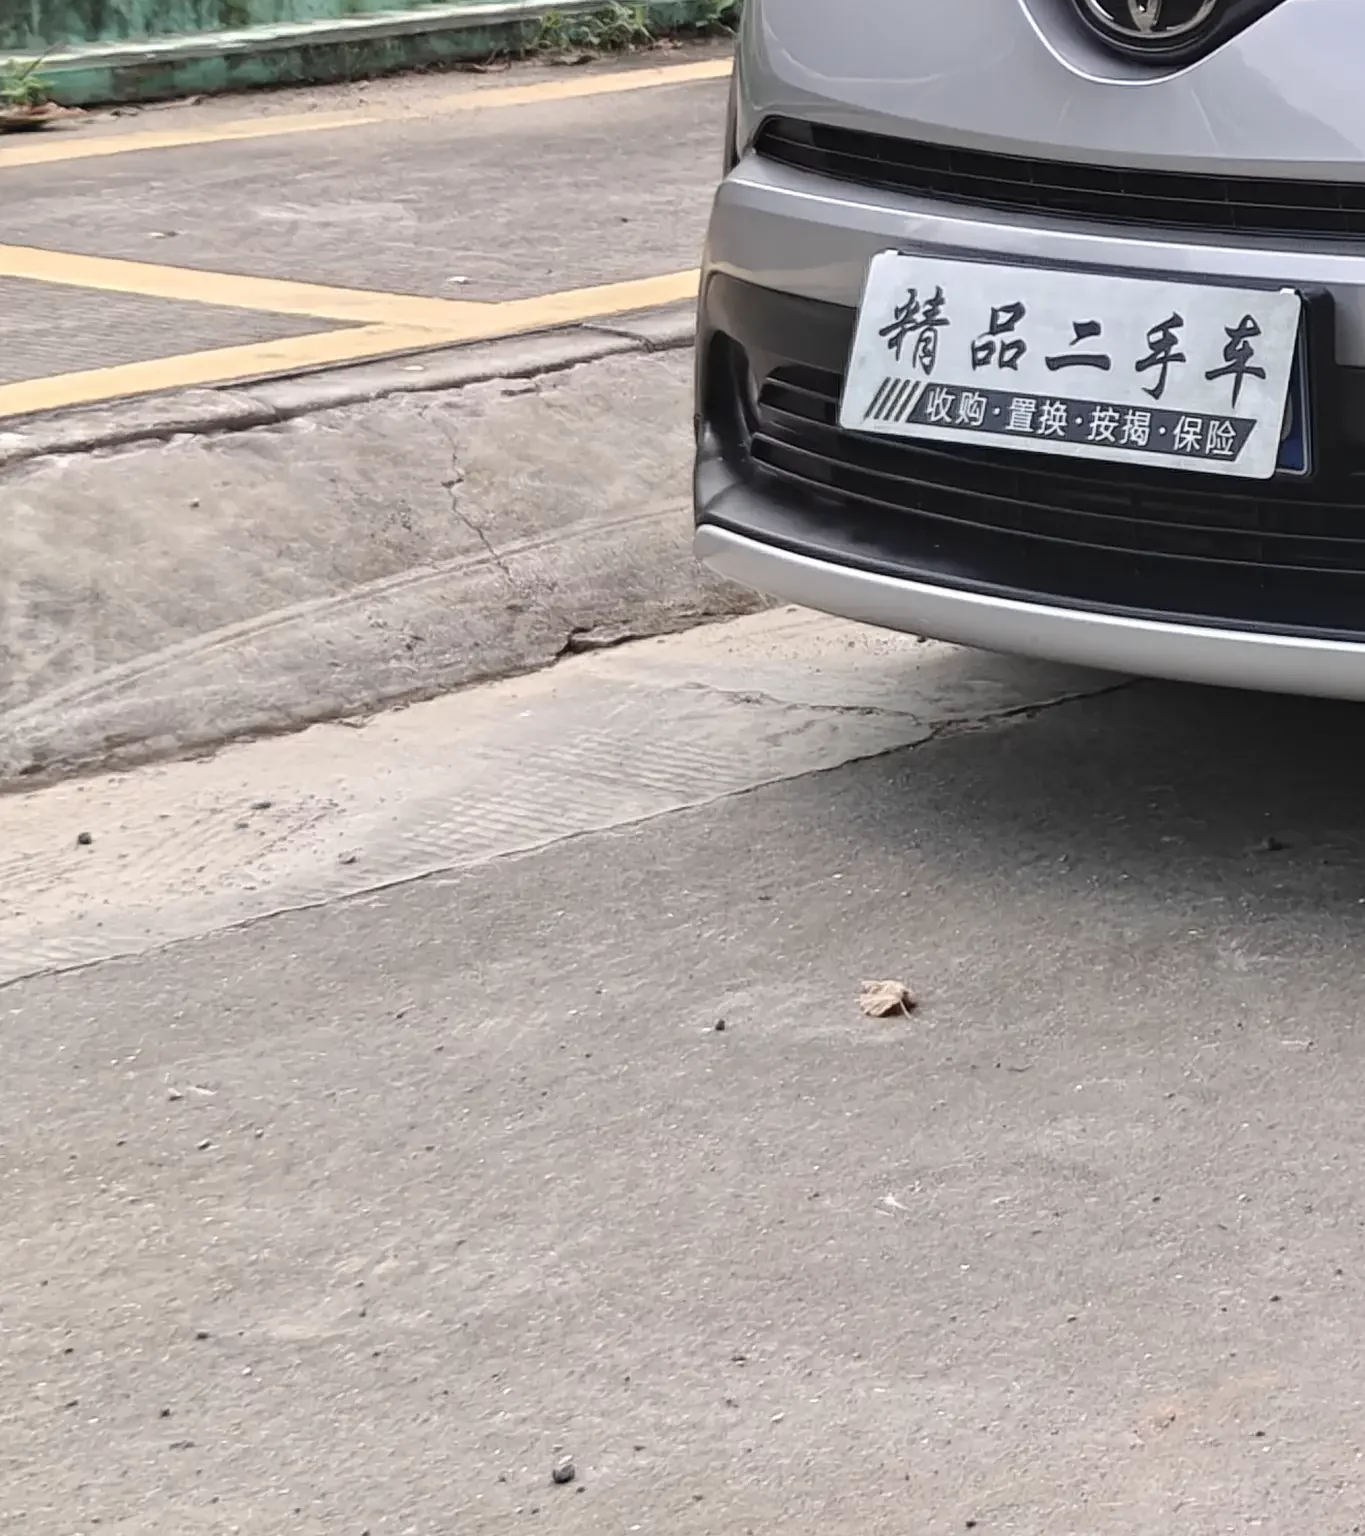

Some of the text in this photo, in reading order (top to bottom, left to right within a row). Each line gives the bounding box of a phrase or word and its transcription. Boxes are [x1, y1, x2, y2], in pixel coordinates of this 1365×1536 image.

[878, 285, 1267, 409] 精品二手车
